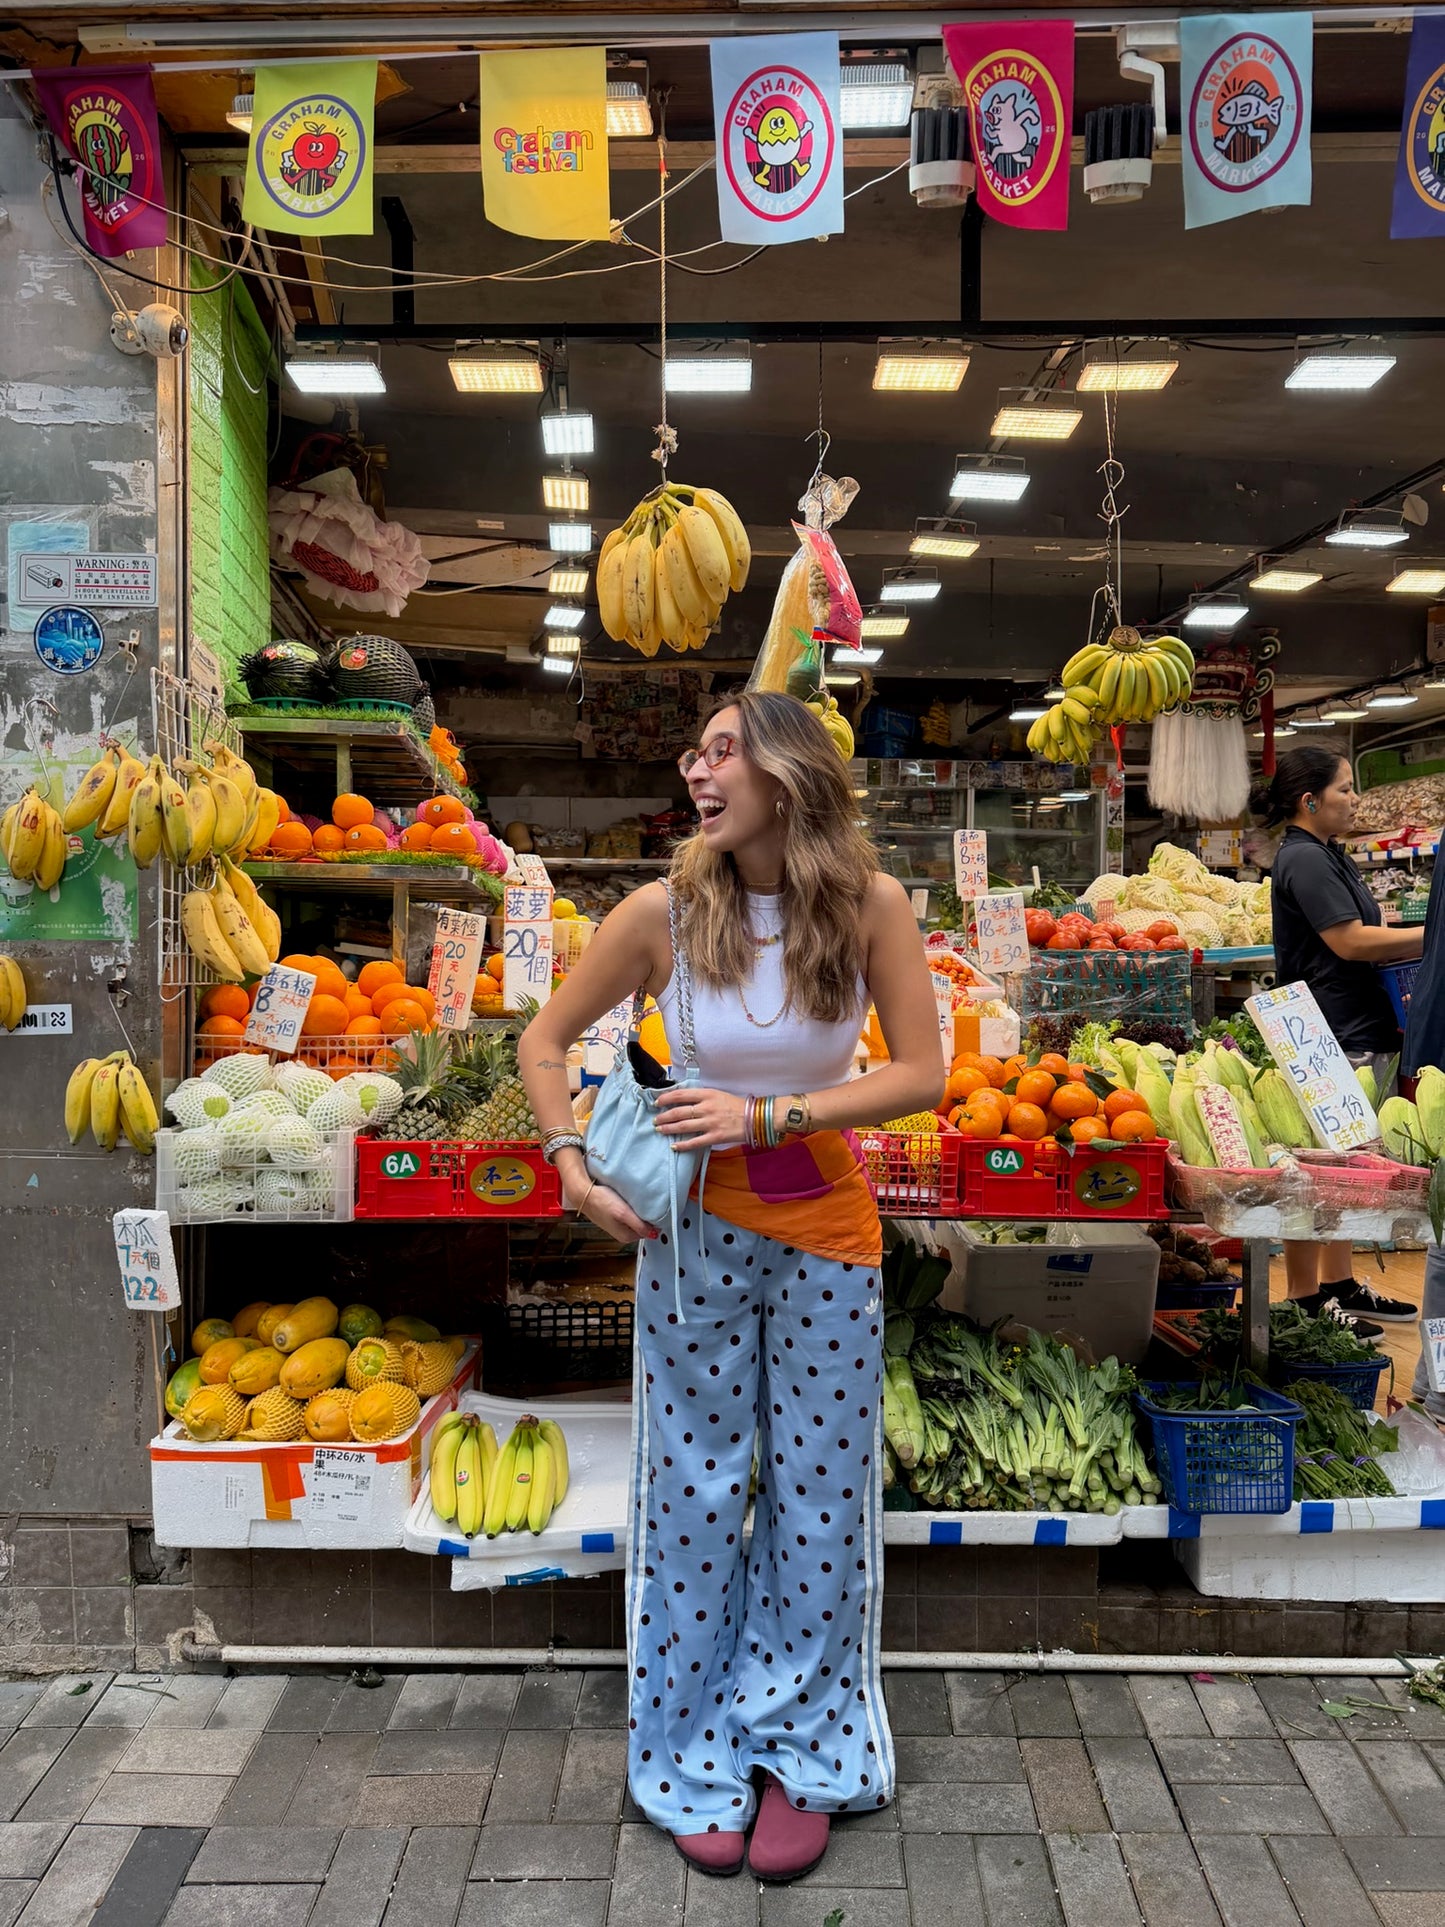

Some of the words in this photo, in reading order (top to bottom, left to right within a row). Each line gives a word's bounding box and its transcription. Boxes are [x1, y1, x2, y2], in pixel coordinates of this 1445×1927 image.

[1202, 44, 1276, 102] GRAHAM
[734, 77, 805, 127] GRAHAM
[272, 104, 342, 140] GRAHAM
[1416, 131, 1426, 139] 20
[493, 126, 594, 154] Graham
[502, 147, 584, 174] festival
[979, 150, 1033, 198] MARKET
[1205, 151, 1274, 184] MARKET
[270, 176, 337, 213] MARKET
[741, 175, 808, 214] MARKET
[75, 559, 129, 569] WARNING:
[445, 940, 466, 960] 20
[524, 956, 549, 985] 個
[385, 1153, 416, 1175] 6A
[991, 1150, 1020, 1169] 6A
[118, 1217, 158, 1249] 木瓜
[315, 1449, 366, 1464] 中环26/水
